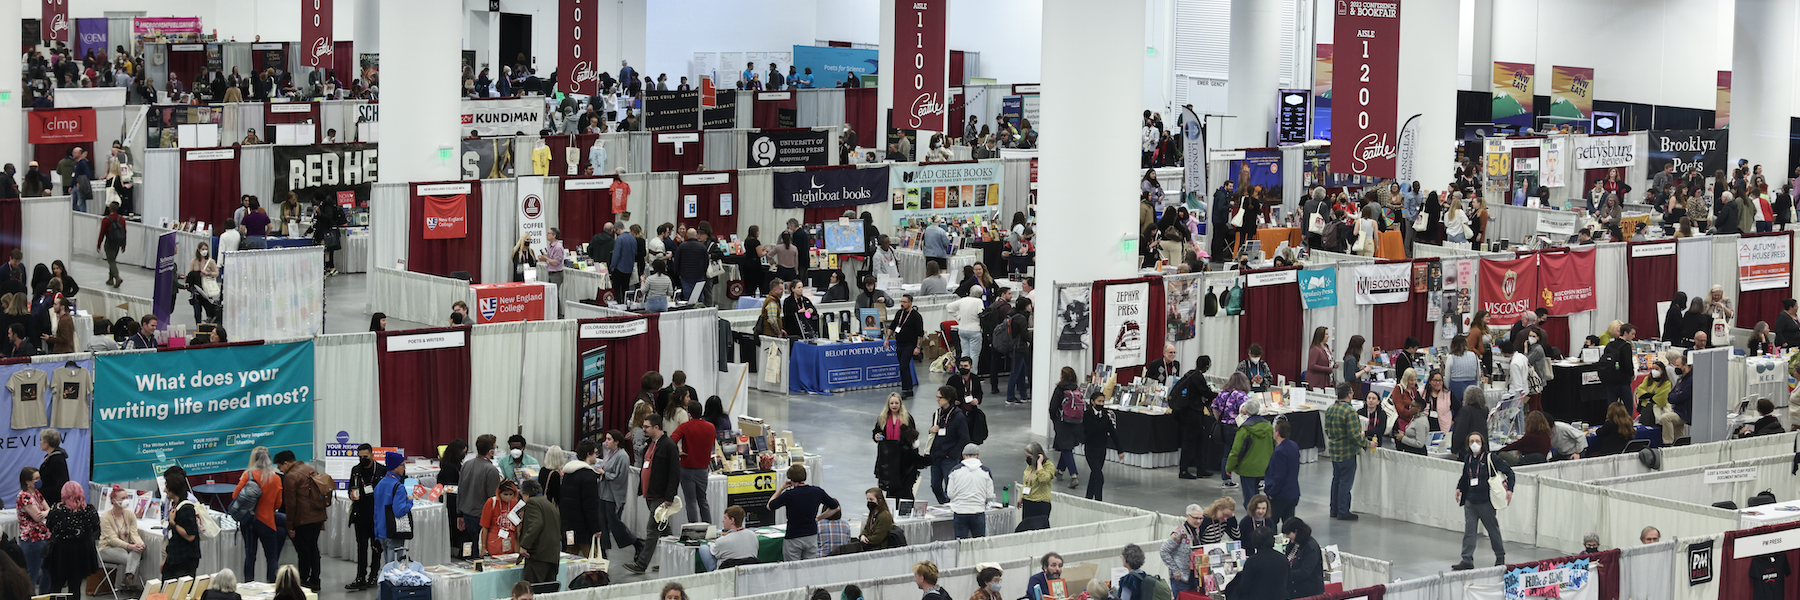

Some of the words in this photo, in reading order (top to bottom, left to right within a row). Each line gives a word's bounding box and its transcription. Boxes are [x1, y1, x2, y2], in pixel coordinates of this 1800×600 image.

[1349, 7, 1356, 15] &
[1357, 8, 1397, 18] BOOKFAIR
[1357, 29, 1375, 38] AISLE
[824, 64, 837, 72] Poets
[838, 64, 846, 72] for
[570, 61, 597, 92] Seattle
[1515, 72, 1530, 84] PNW
[1573, 76, 1589, 89] PNW
[1512, 79, 1527, 92] EATS
[1571, 84, 1586, 97] EATS
[909, 92, 943, 128] Seattle
[476, 112, 538, 123] KUNDIMAN
[1595, 138, 1605, 146] the
[1660, 136, 1716, 155] Brooklyn
[1352, 133, 1395, 173] Seattle
[1575, 140, 1633, 163] Gettysburg
[289, 152, 340, 191] RED
[1488, 153, 1509, 176] 50
[1672, 157, 1703, 173] Poets
[914, 169, 933, 180] MAD
[935, 168, 962, 178] CREEK
[964, 167, 993, 177] BOOKS
[792, 188, 840, 205] nightboat
[843, 186, 871, 200] books
[1357, 277, 1411, 295] WISCONSIN
[500, 296, 515, 305] New
[516, 292, 542, 302] England
[1116, 289, 1140, 303] ZEPHYR
[500, 304, 524, 313] College
[1118, 304, 1138, 316] PRESS
[825, 349, 847, 357] BELOIT
[849, 347, 873, 355] POETRY
[136, 370, 188, 391] What
[191, 369, 234, 387] does
[237, 367, 279, 386] your
[100, 400, 168, 420] writing
[174, 397, 203, 414] life
[208, 392, 251, 411] need
[255, 386, 310, 408] most?
[0, 433, 66, 449] REVIW
[754, 475, 773, 490] CR
[1692, 553, 1708, 570] PM
